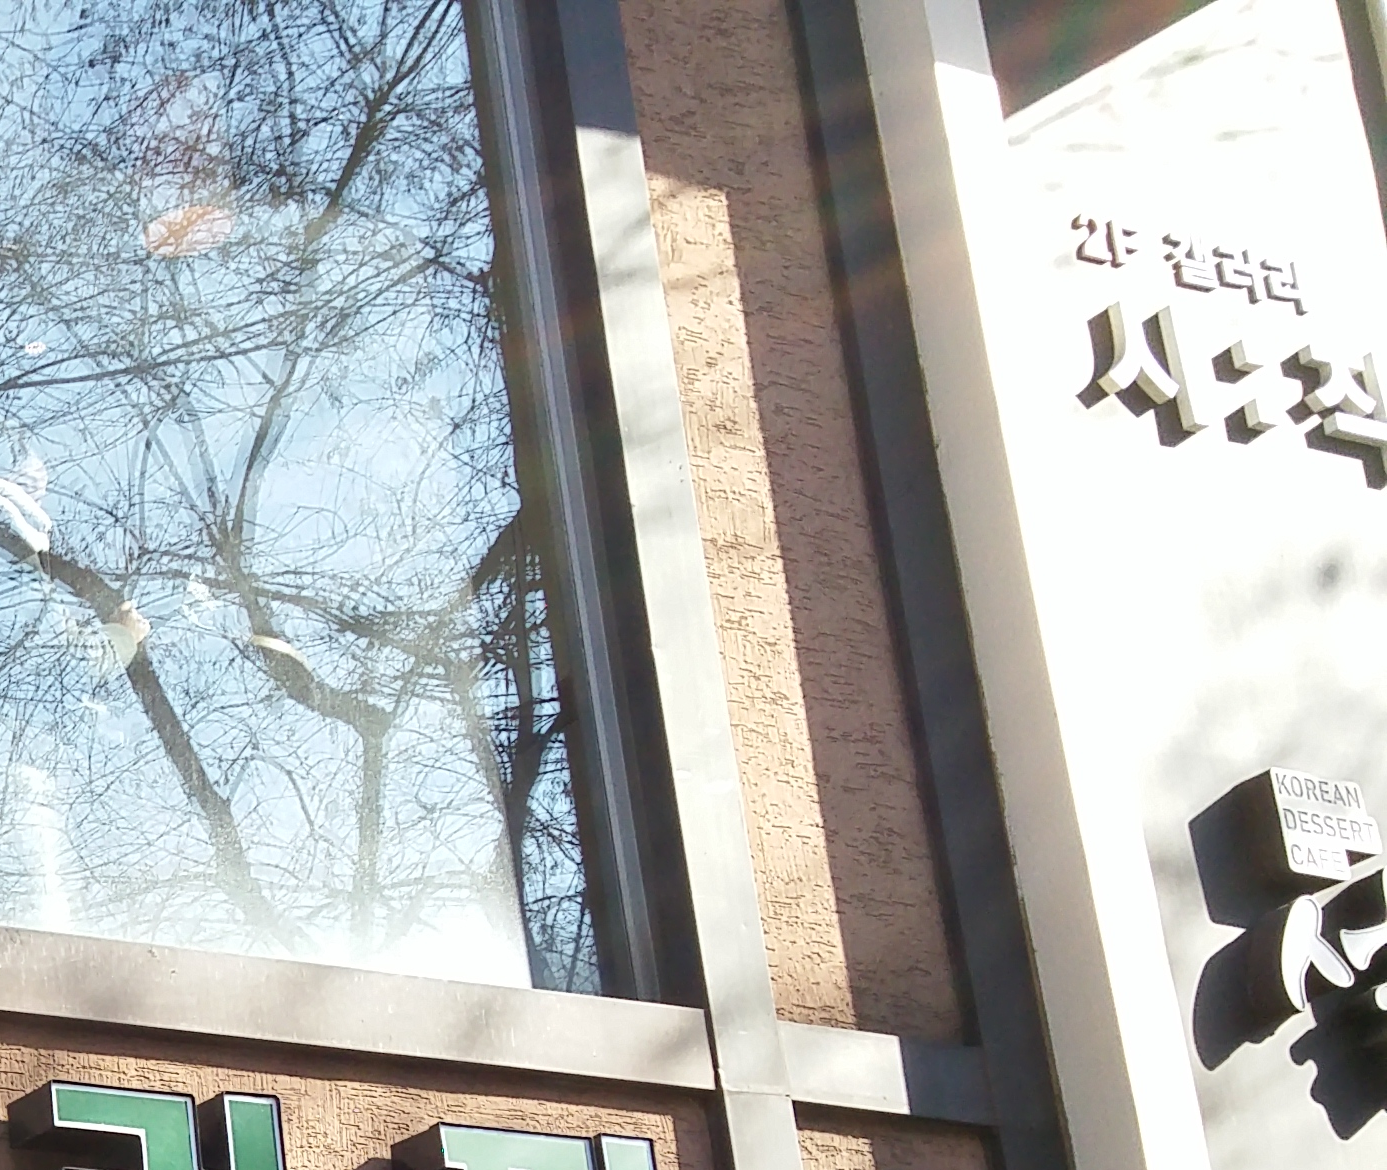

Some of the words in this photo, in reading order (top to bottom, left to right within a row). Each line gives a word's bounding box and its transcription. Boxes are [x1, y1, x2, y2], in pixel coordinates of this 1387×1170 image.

[1161, 229, 1309, 317] 갤러리
[1275, 773, 1361, 809] KOREAN
[1282, 808, 1374, 842] DESSERT
[1290, 843, 1345, 873] CAFE
